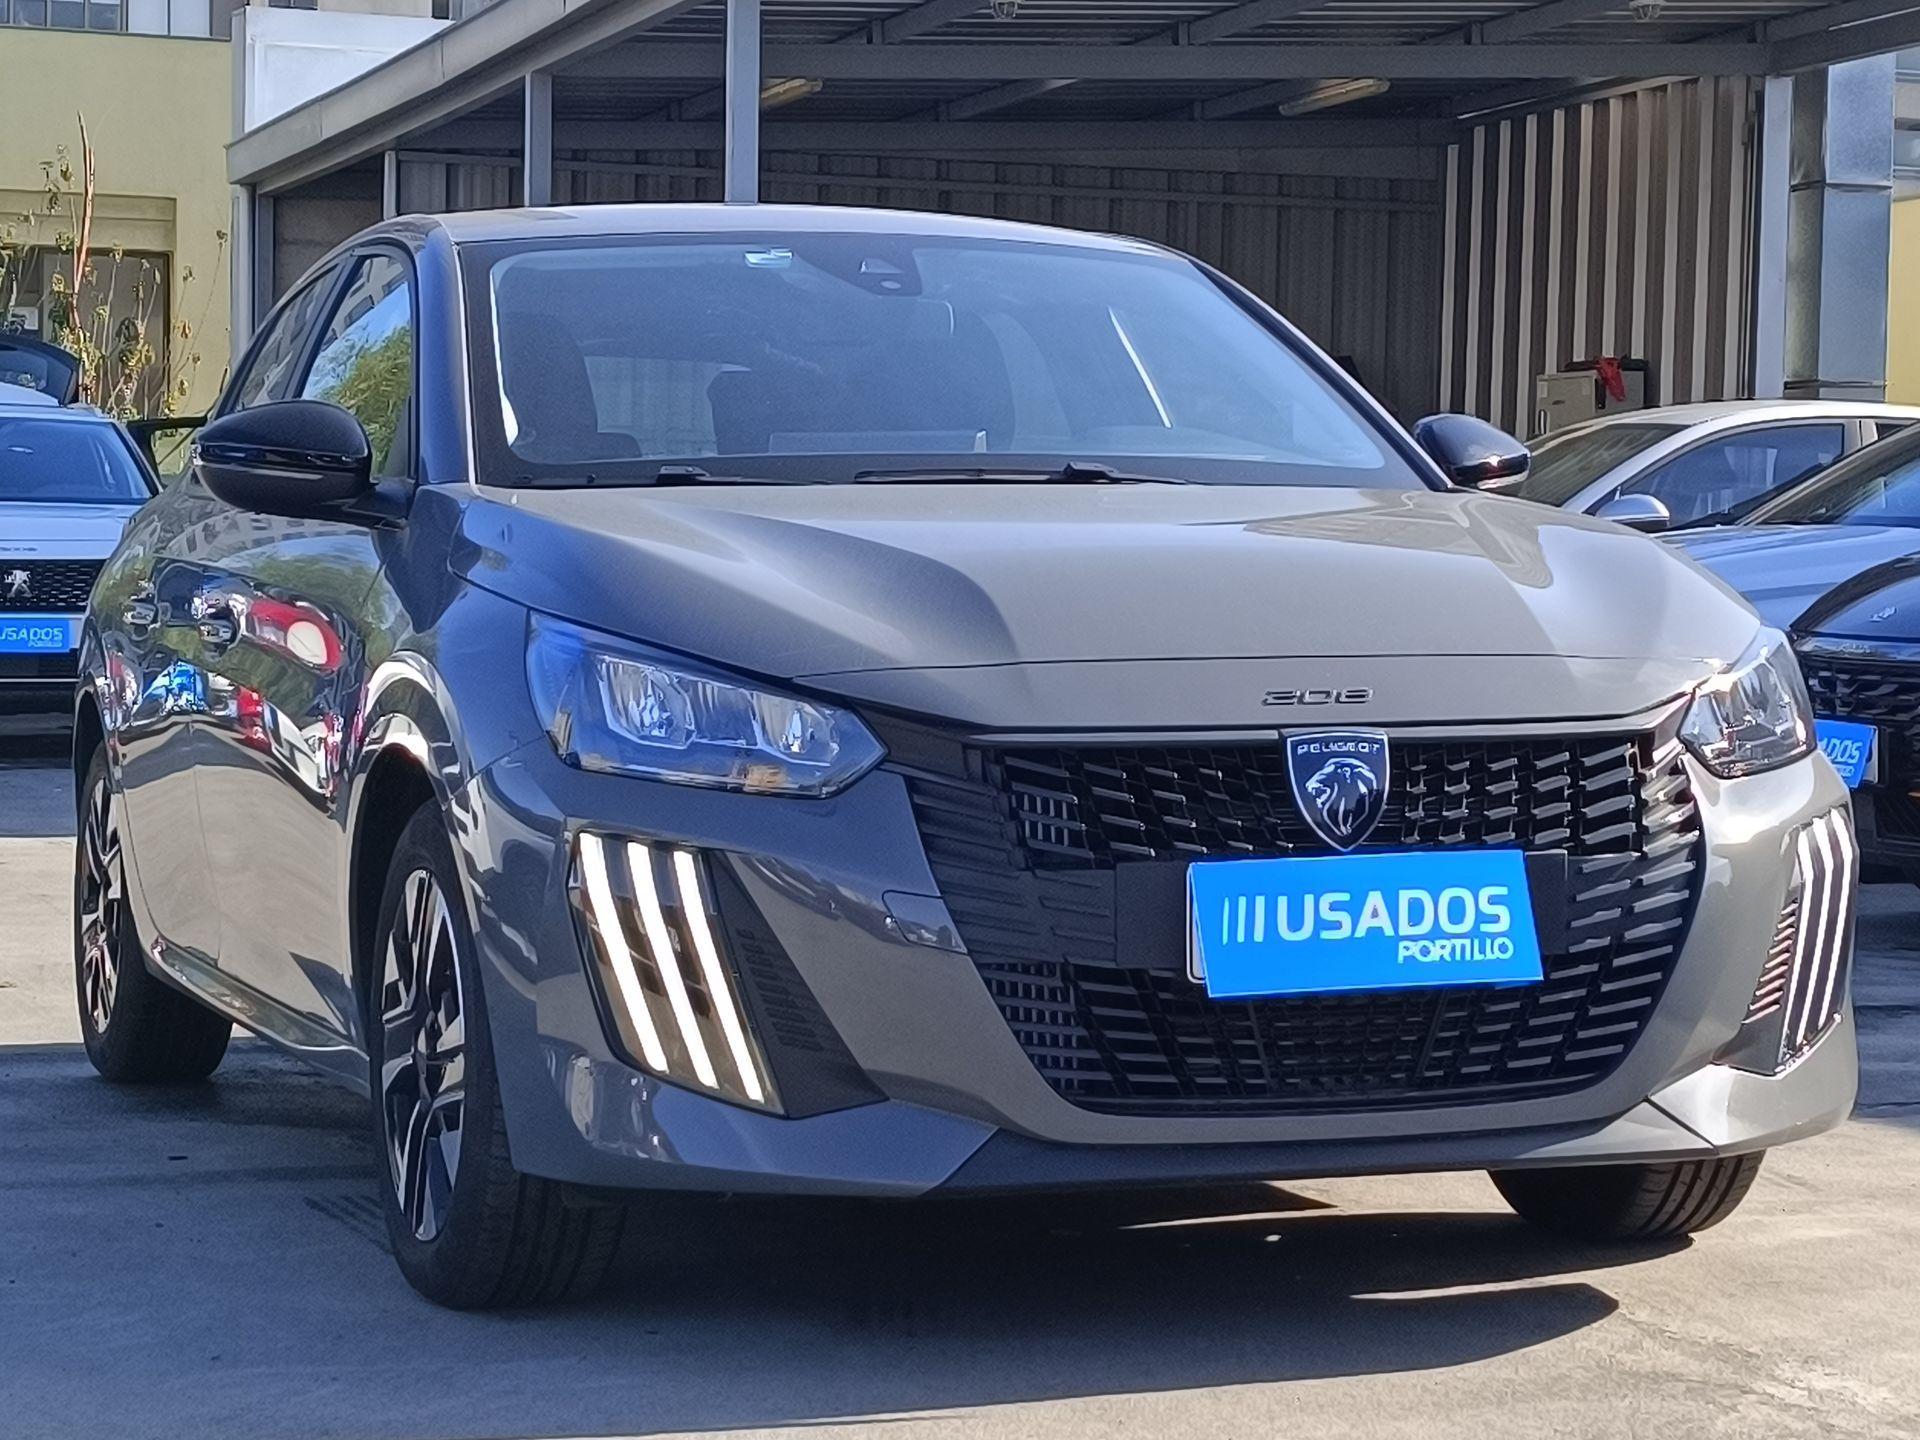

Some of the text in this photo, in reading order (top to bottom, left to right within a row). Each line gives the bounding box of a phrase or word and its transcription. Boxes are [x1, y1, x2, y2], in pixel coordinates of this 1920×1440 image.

[1262, 687, 1374, 707] 208
[1296, 742, 1380, 756] PEUGEOT
[1277, 886, 1512, 941] USADOS
[1397, 937, 1515, 964] PORTILLO
